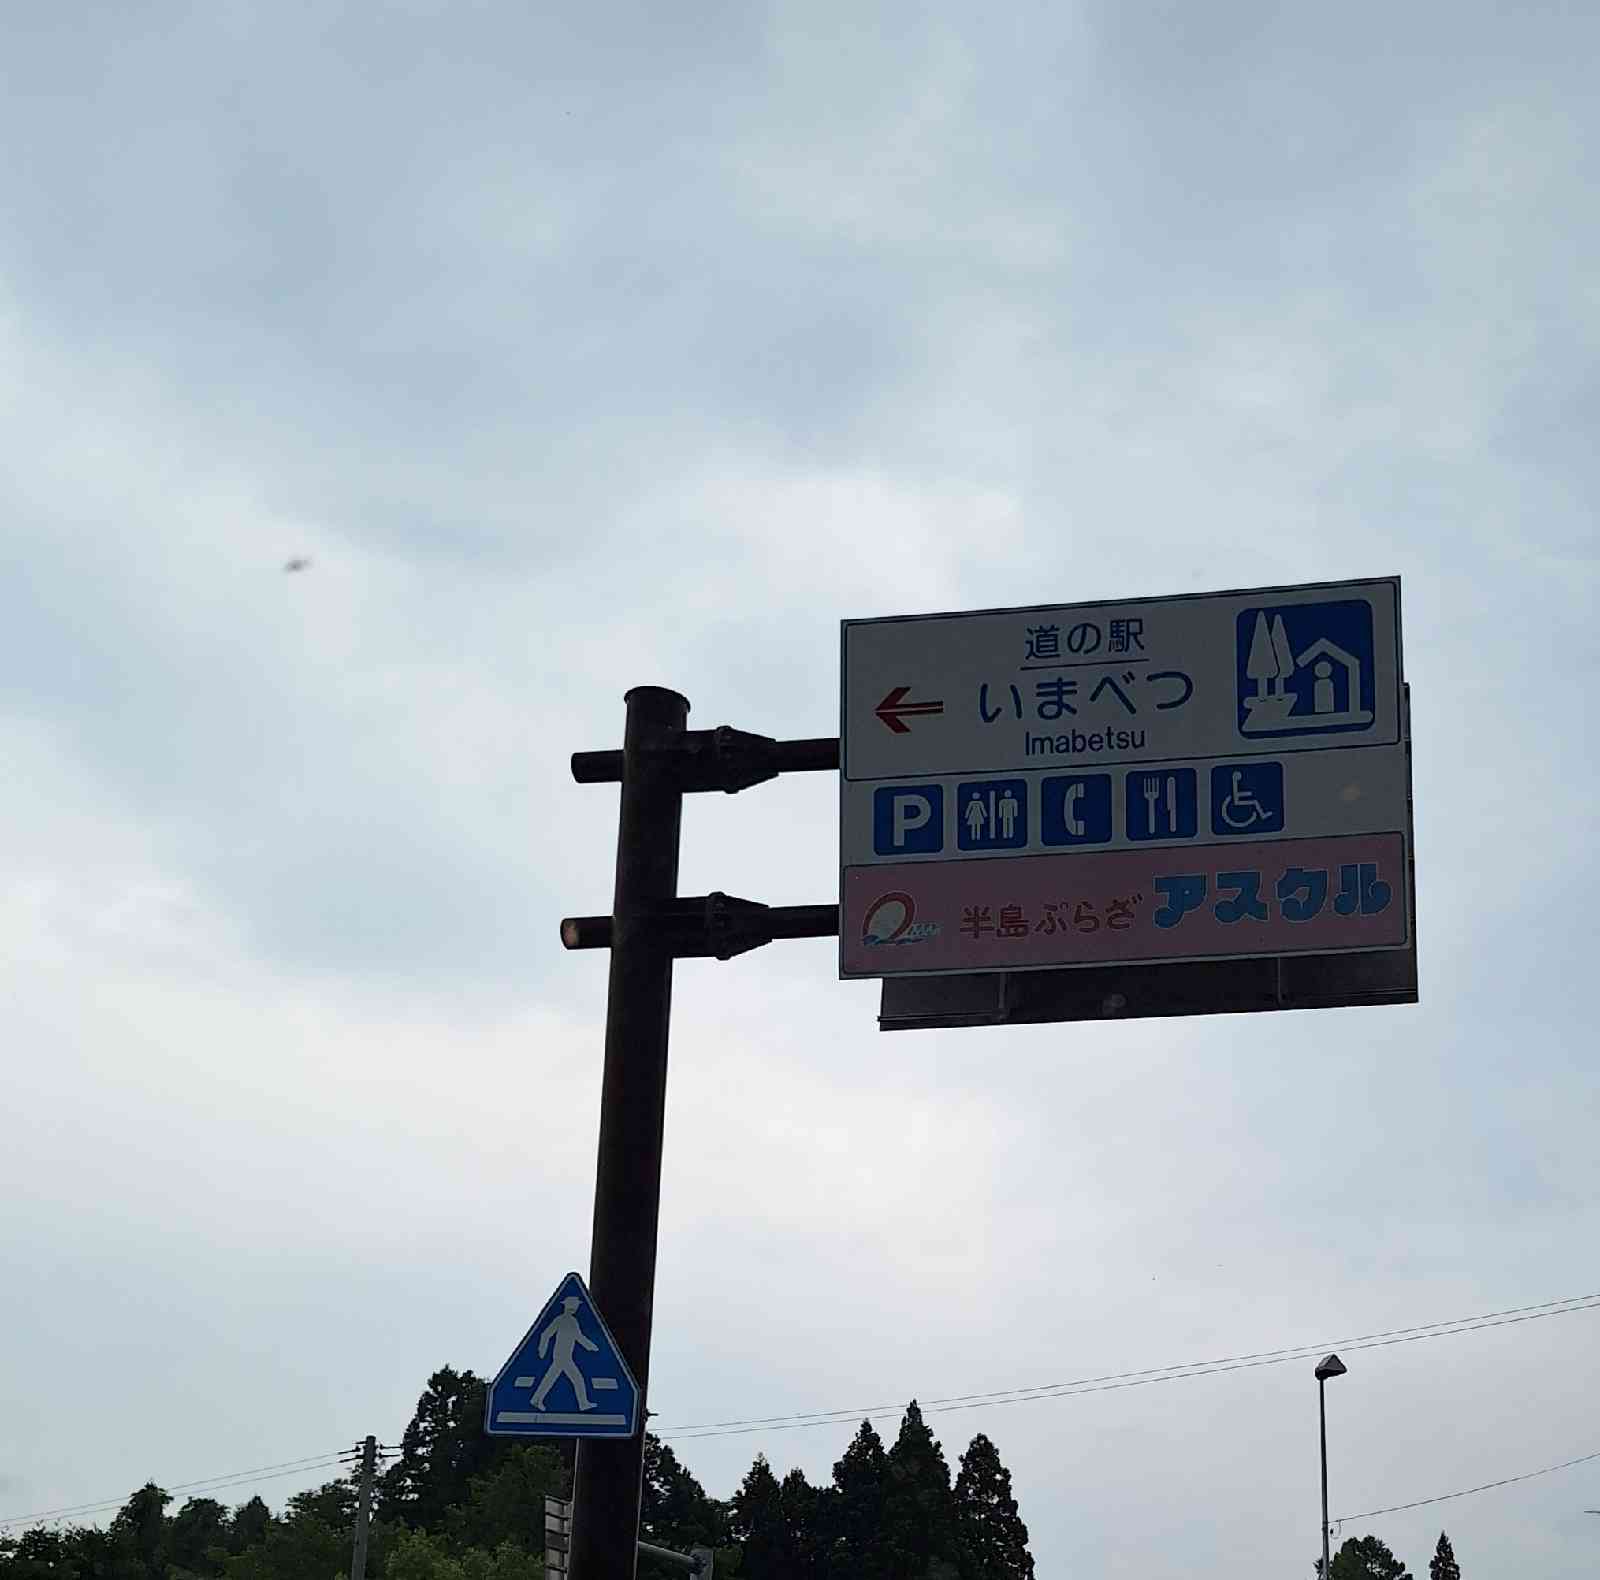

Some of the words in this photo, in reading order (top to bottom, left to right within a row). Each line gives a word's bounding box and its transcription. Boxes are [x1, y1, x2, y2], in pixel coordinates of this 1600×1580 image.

[1025, 618, 1145, 660] 道の駅
[979, 671, 1194, 723] いまべつ
[1025, 729, 1145, 757] Imabetsu
[893, 794, 932, 848] P
[960, 893, 1143, 939] 半島ぷらざ
[1152, 863, 1392, 929] アスクル
